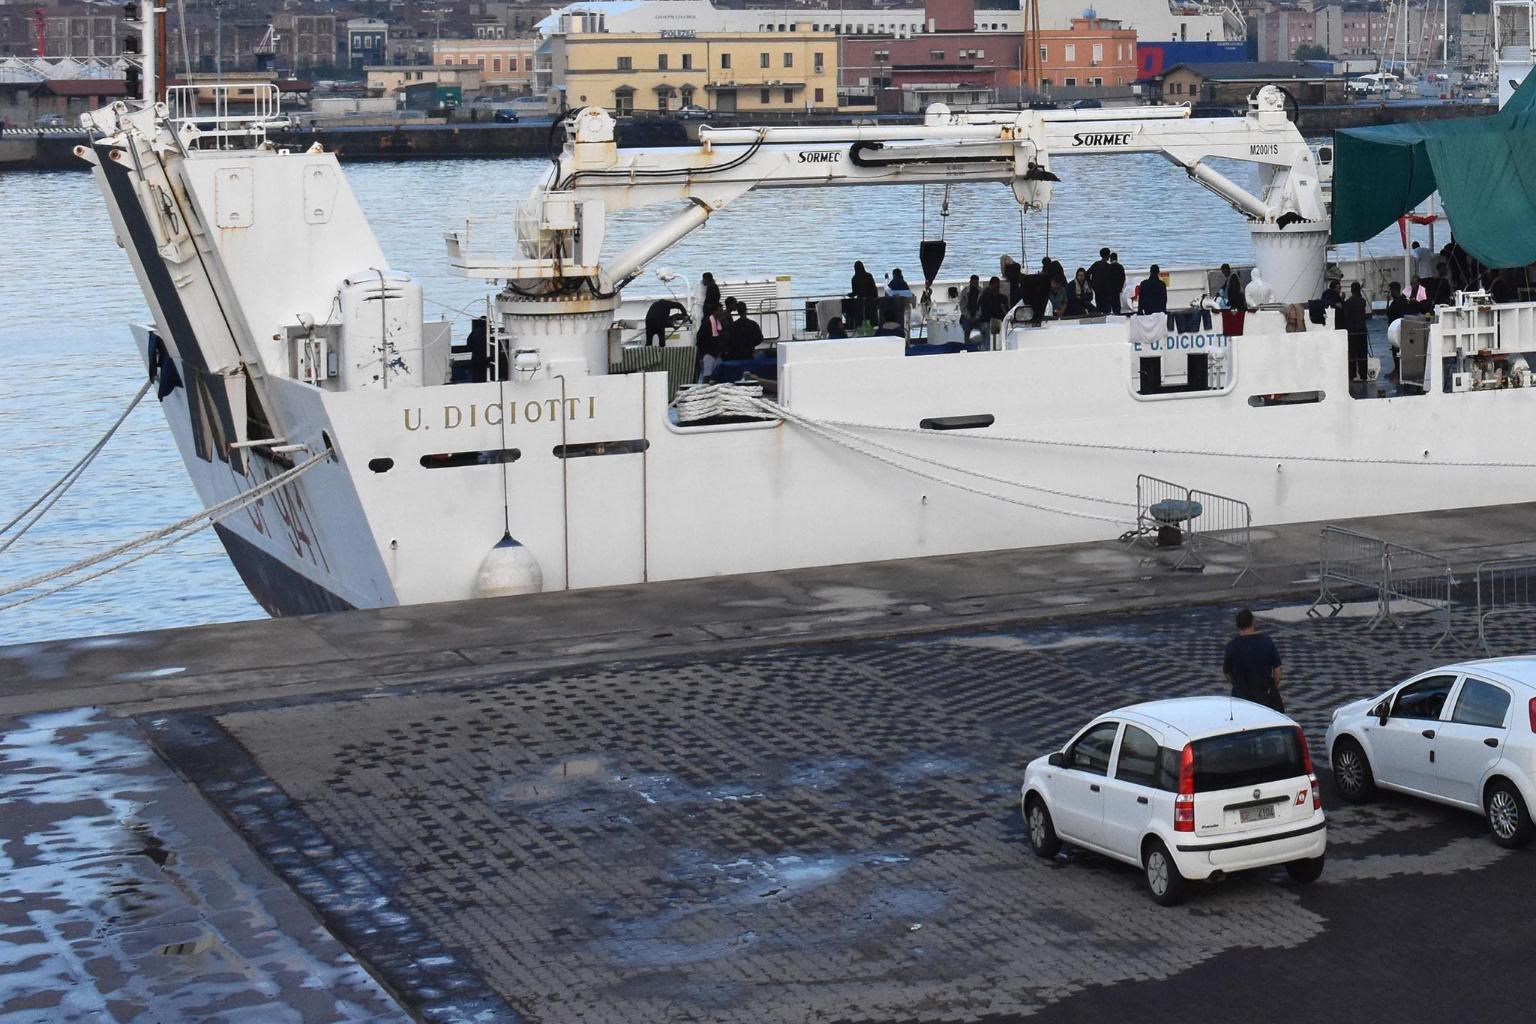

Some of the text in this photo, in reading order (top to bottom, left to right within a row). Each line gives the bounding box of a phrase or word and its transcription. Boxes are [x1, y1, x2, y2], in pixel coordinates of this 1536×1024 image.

[1071, 132, 1131, 147] SORMEC
[1249, 144, 1279, 155] M200/1S
[797, 151, 841, 164] SORMEC
[1166, 333, 1228, 350] DICIOTTI
[403, 396, 596, 432] U. DICIOTTI
